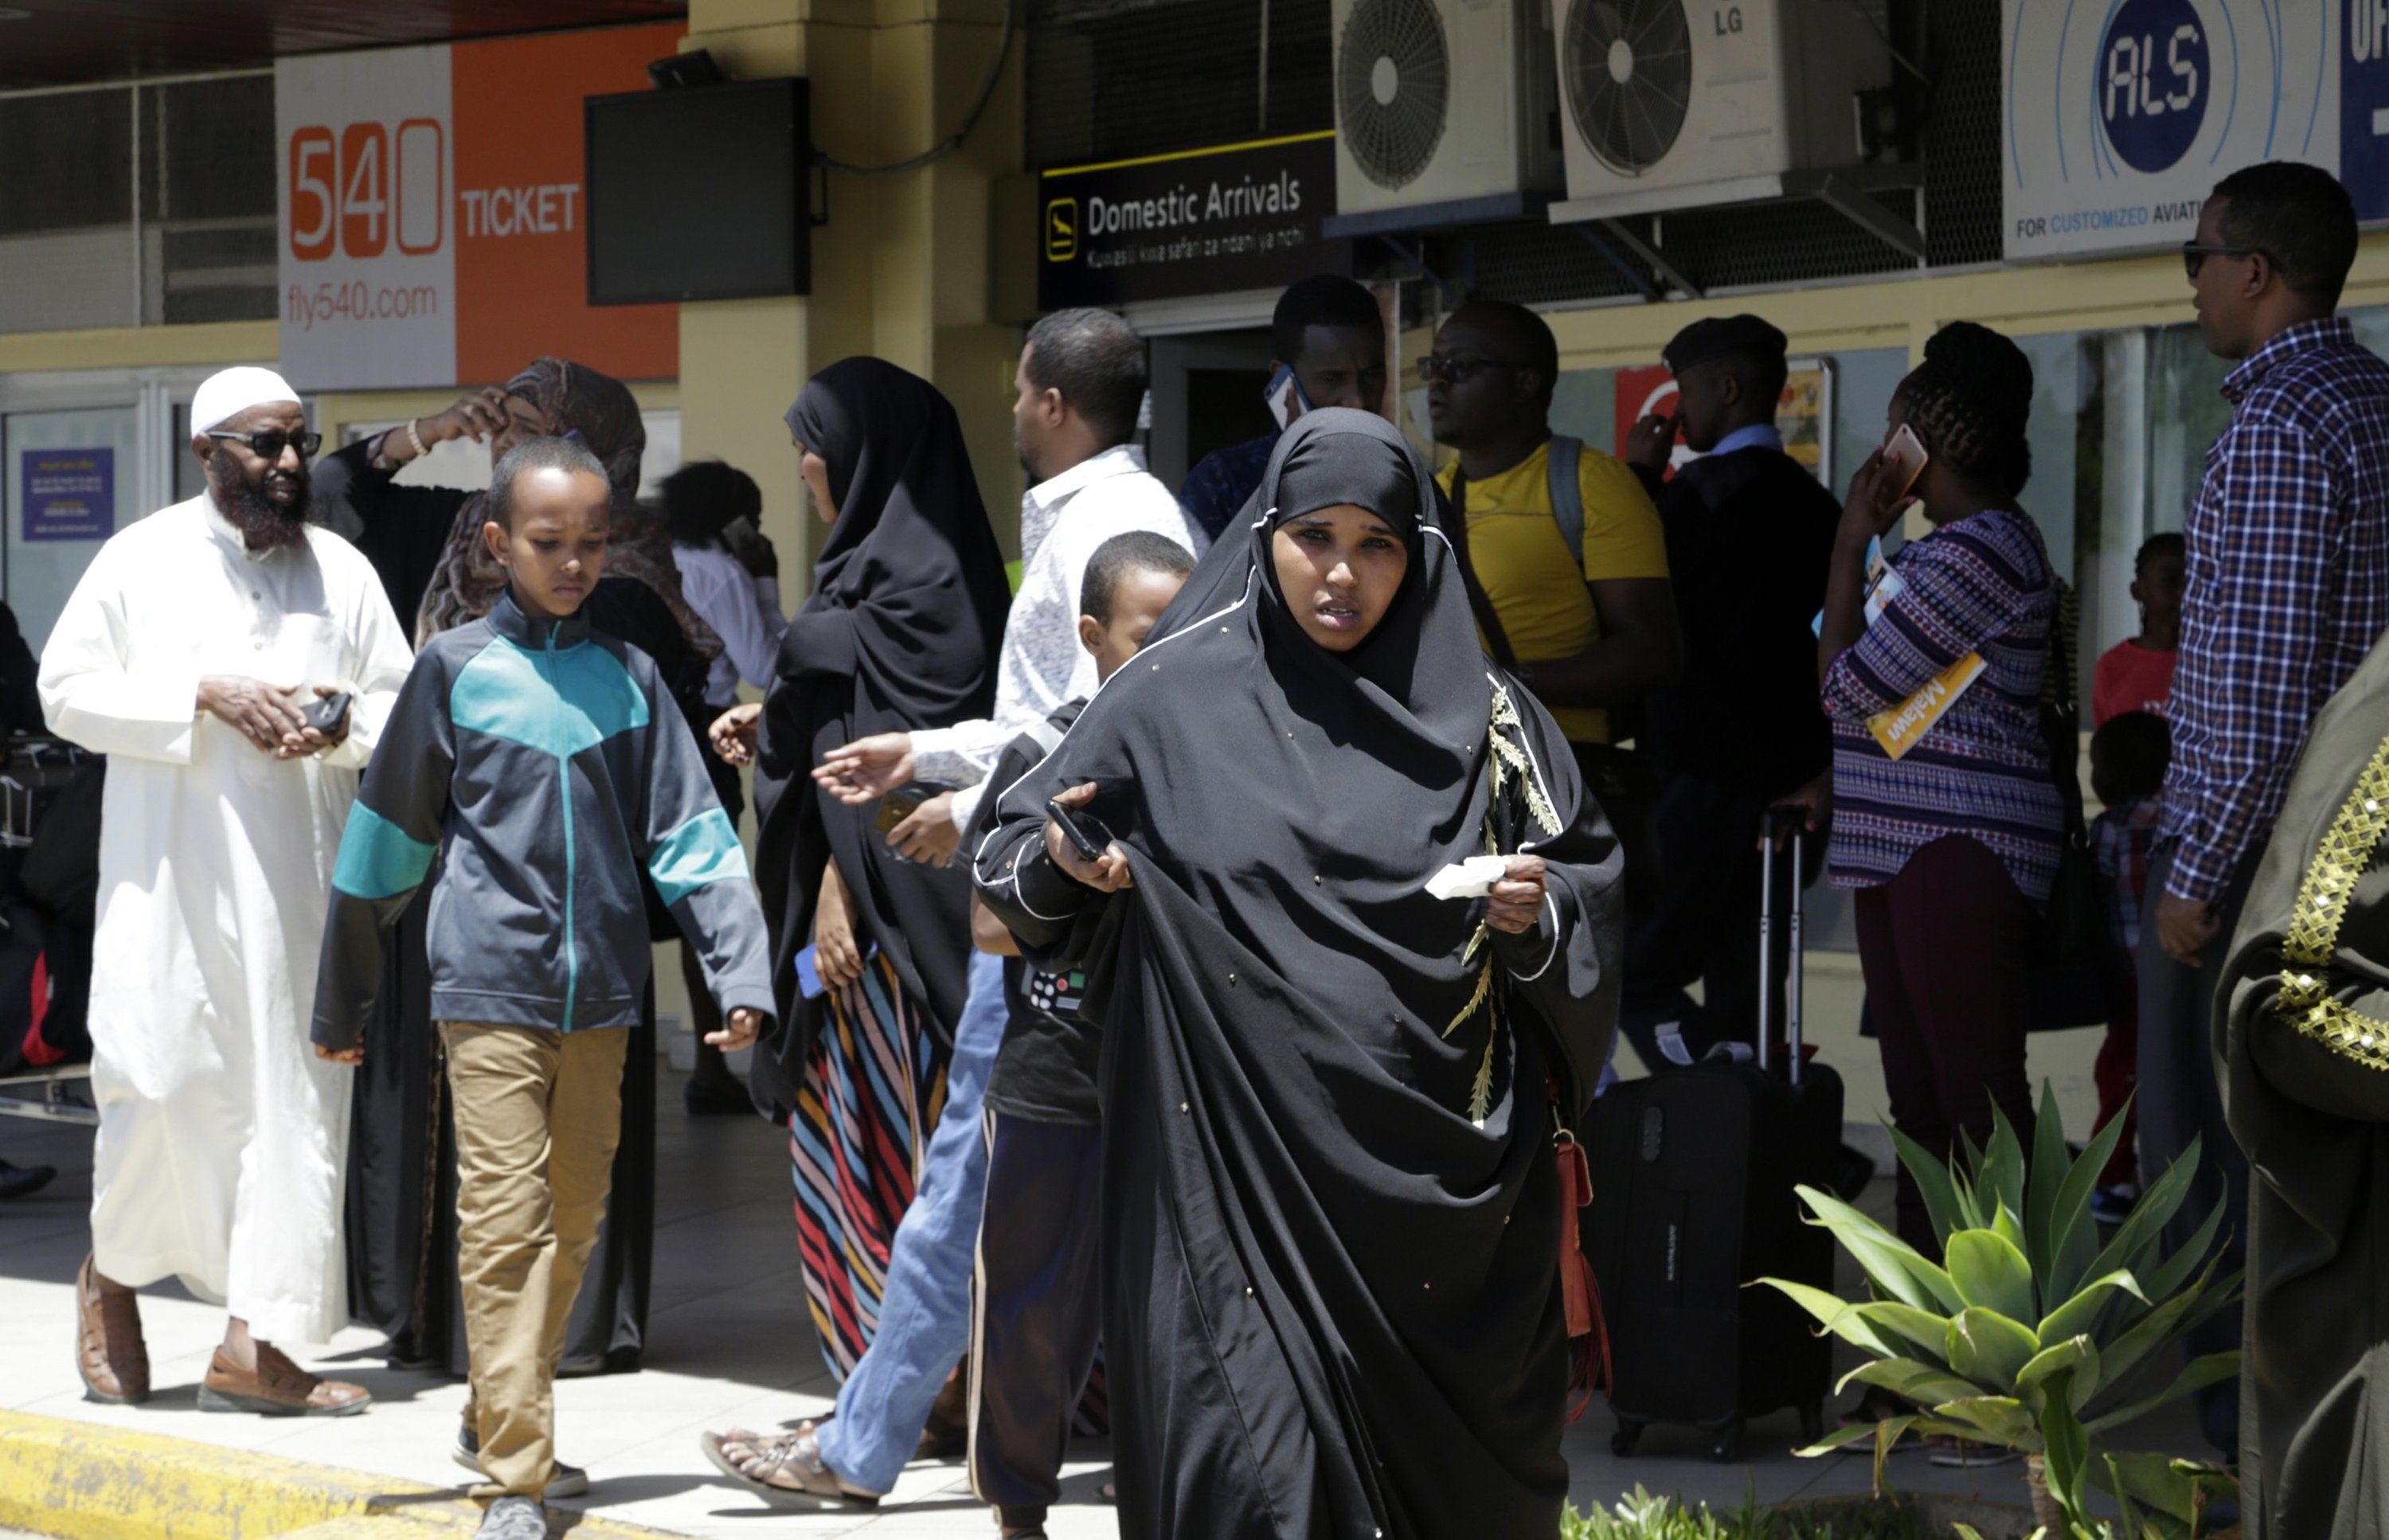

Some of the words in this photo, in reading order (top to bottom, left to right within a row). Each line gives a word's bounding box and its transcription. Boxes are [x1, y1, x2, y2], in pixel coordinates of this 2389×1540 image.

[1714, 6, 1743, 36] LG
[2106, 24, 2199, 121] ALS
[290, 118, 444, 261] 540
[460, 183, 581, 237] TICKET
[1089, 183, 1198, 236] Domestic
[1204, 170, 1300, 221] Arrivals
[2016, 217, 2047, 239] FOR
[2050, 205, 2149, 234] CUSTOMIZED
[2152, 200, 2203, 224] AVIATI
[287, 280, 437, 332] fly540.com
